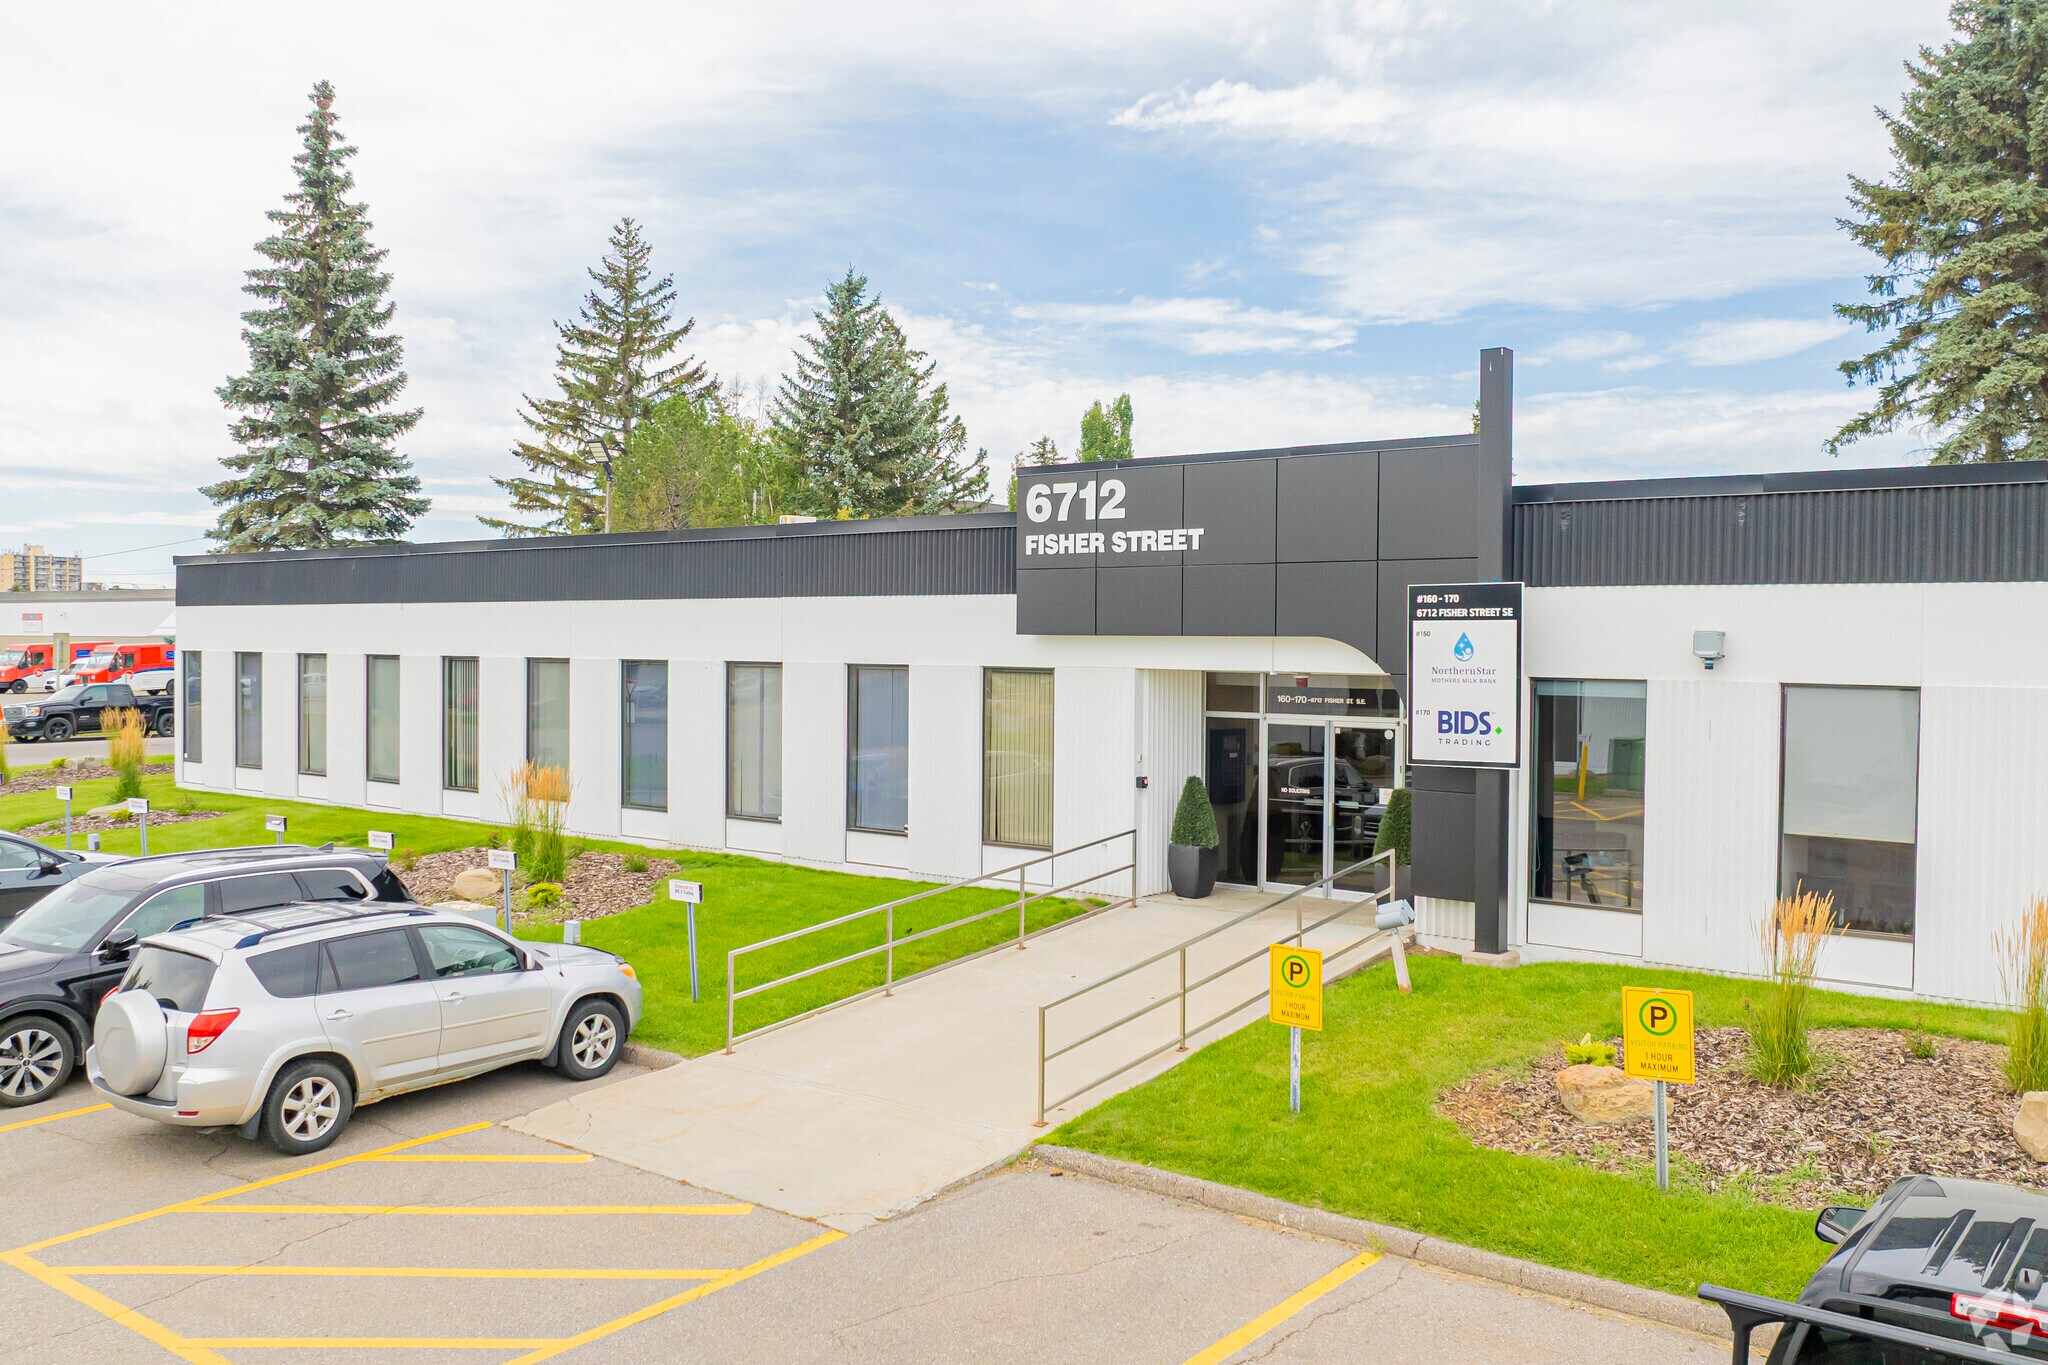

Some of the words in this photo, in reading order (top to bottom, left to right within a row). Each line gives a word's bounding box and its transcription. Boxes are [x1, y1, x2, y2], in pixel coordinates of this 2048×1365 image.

[1026, 479, 1126, 523] 6712
[1025, 532, 1105, 555] FISHER
[1111, 528, 1204, 553] STREET
[1416, 595, 1438, 604] #160
[1444, 594, 1460, 603] 170
[1416, 609, 1438, 617] 6712
[1439, 608, 1468, 617] FISHER
[1469, 608, 1501, 617] STREET
[1502, 607, 1514, 617] SE
[1431, 666, 1497, 675] NorthernStar
[1437, 710, 1492, 735] BIDS
[1438, 738, 1491, 746] TRADING
[1289, 1002, 1306, 1011] HOUR
[1281, 1009, 1310, 1021] MAXIMUM
[1630, 1039, 1656, 1048] VISITOR
[1658, 1041, 1689, 1051] PARKING
[1650, 1052, 1673, 1062] HOUR
[1640, 1062, 1679, 1074] MAXIMUM
